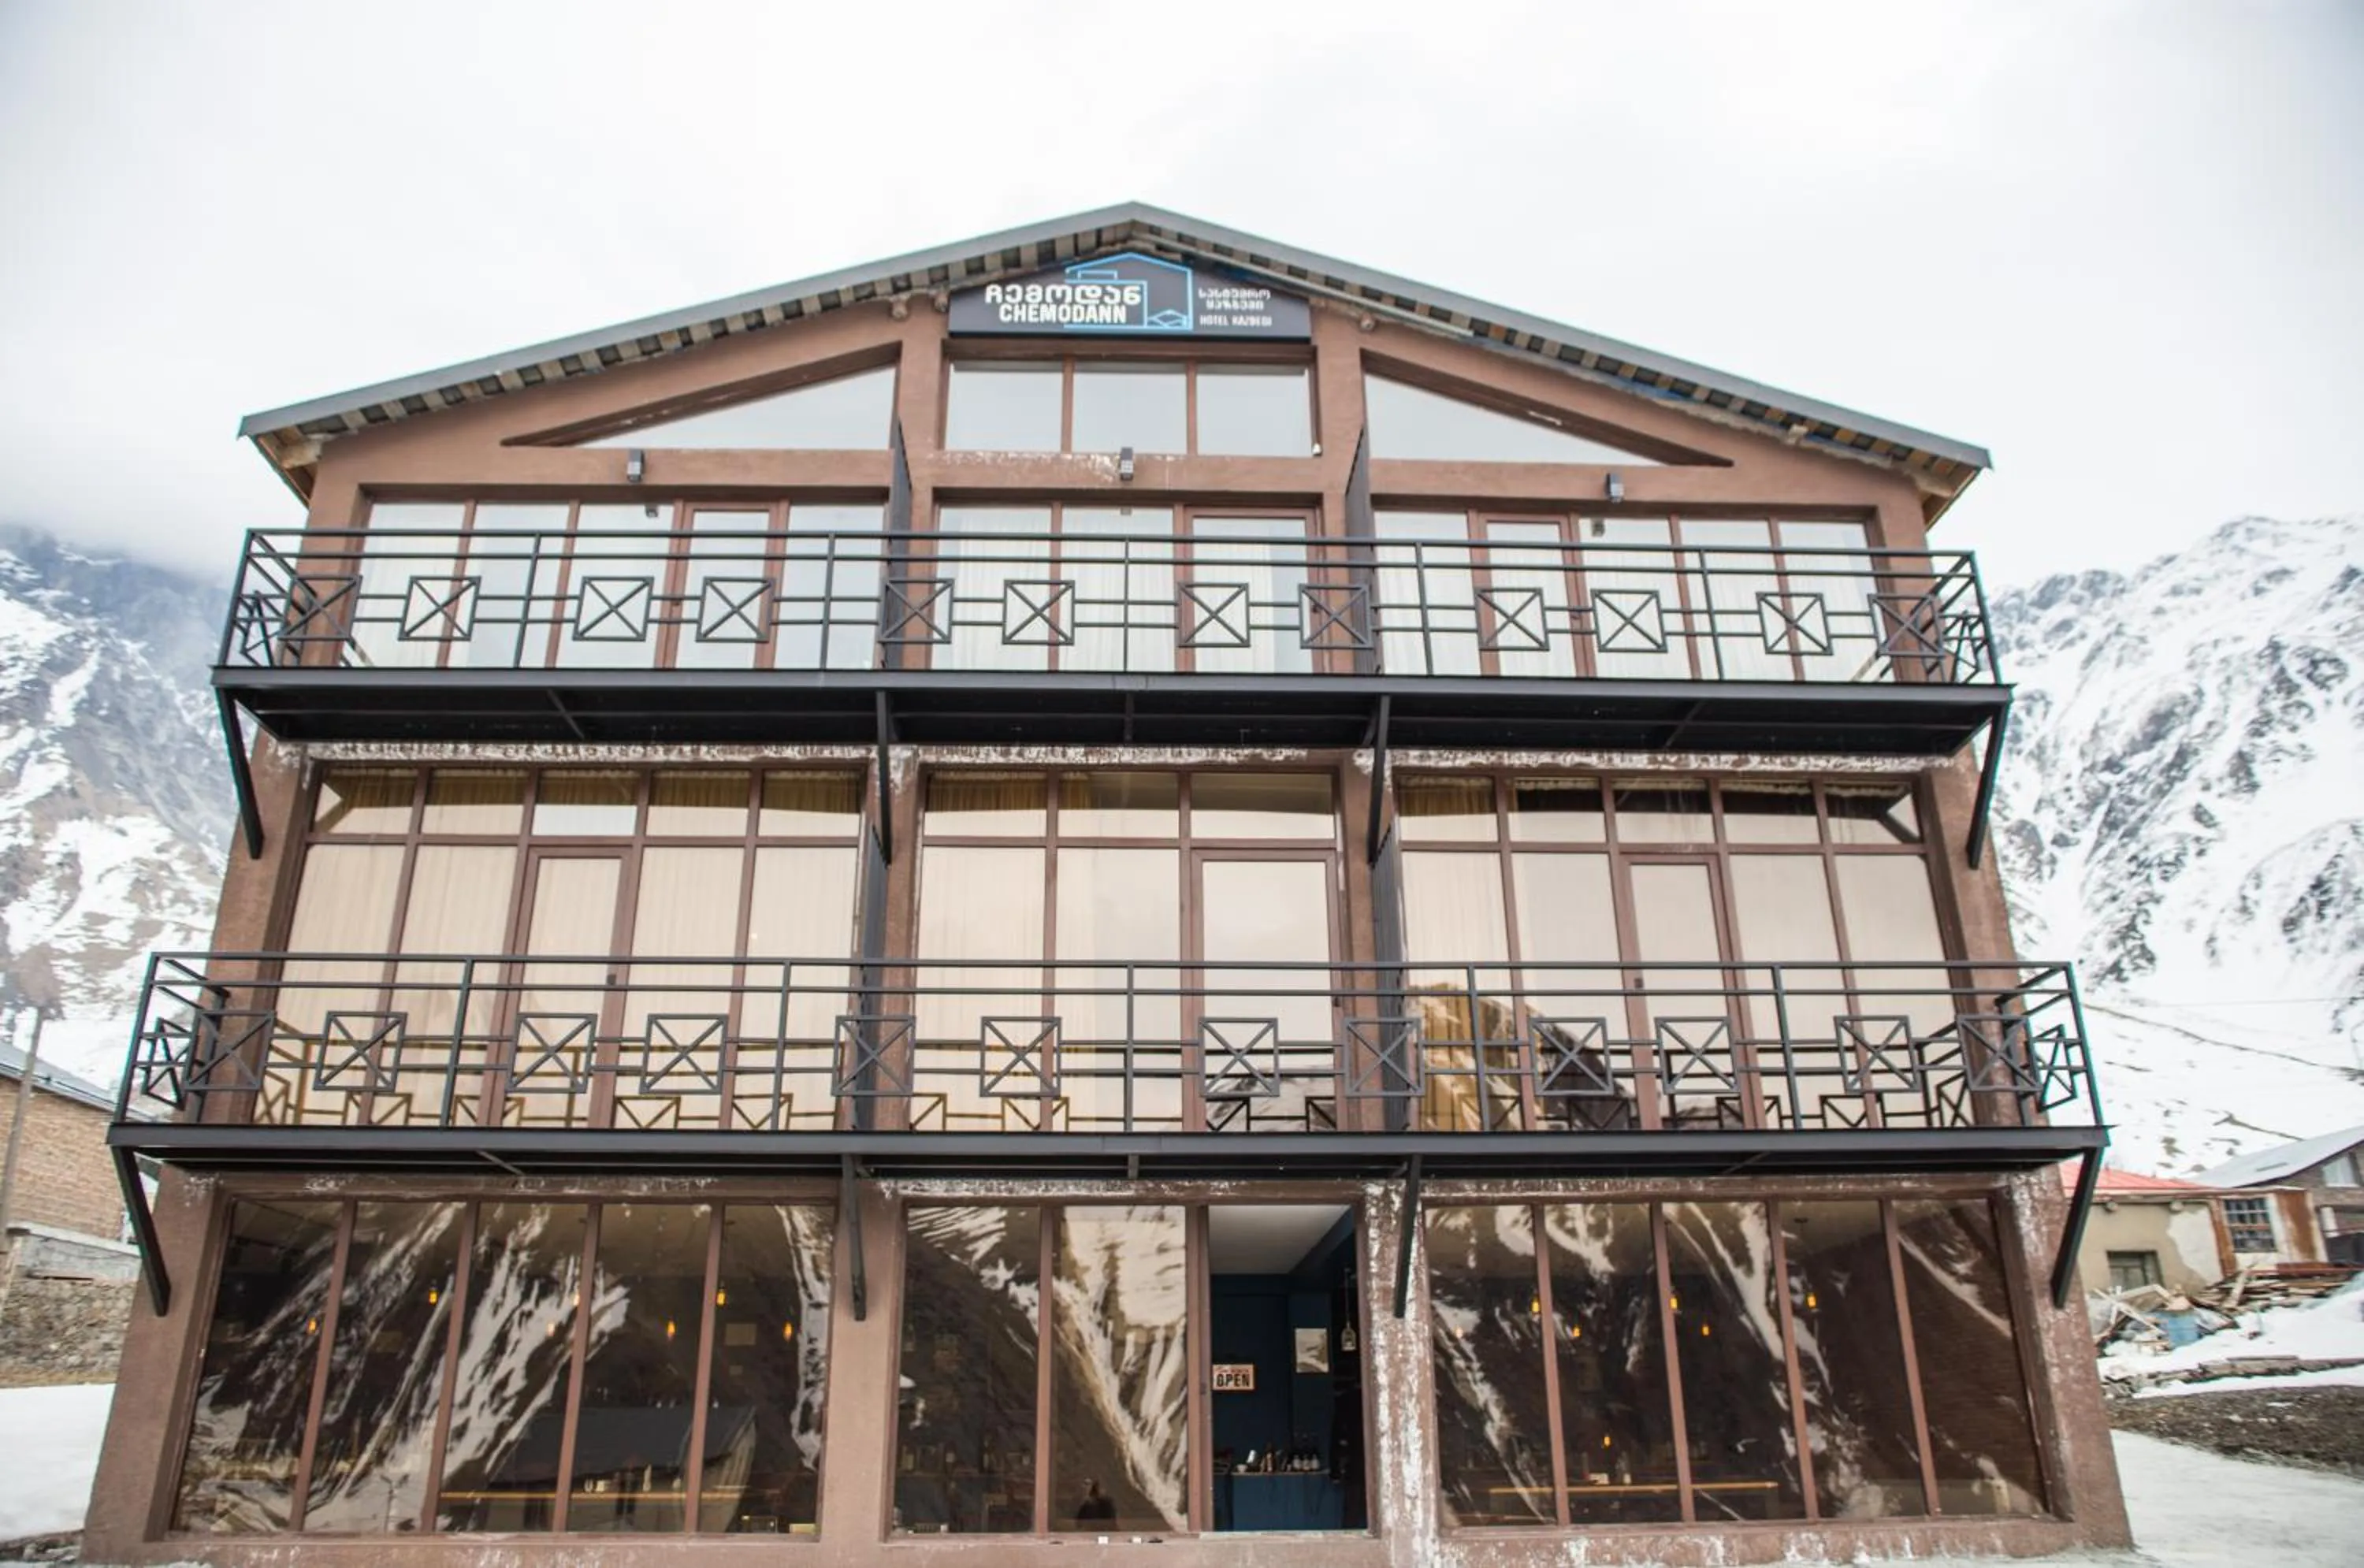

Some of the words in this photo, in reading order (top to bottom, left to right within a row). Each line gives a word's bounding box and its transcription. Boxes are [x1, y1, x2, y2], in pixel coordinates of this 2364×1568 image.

[985, 284, 1141, 305] ჩემოდან
[998, 303, 1127, 324] CHEMODANN
[1200, 314, 1228, 325] HOTEL
[1217, 1373, 1250, 1387] OPEN
